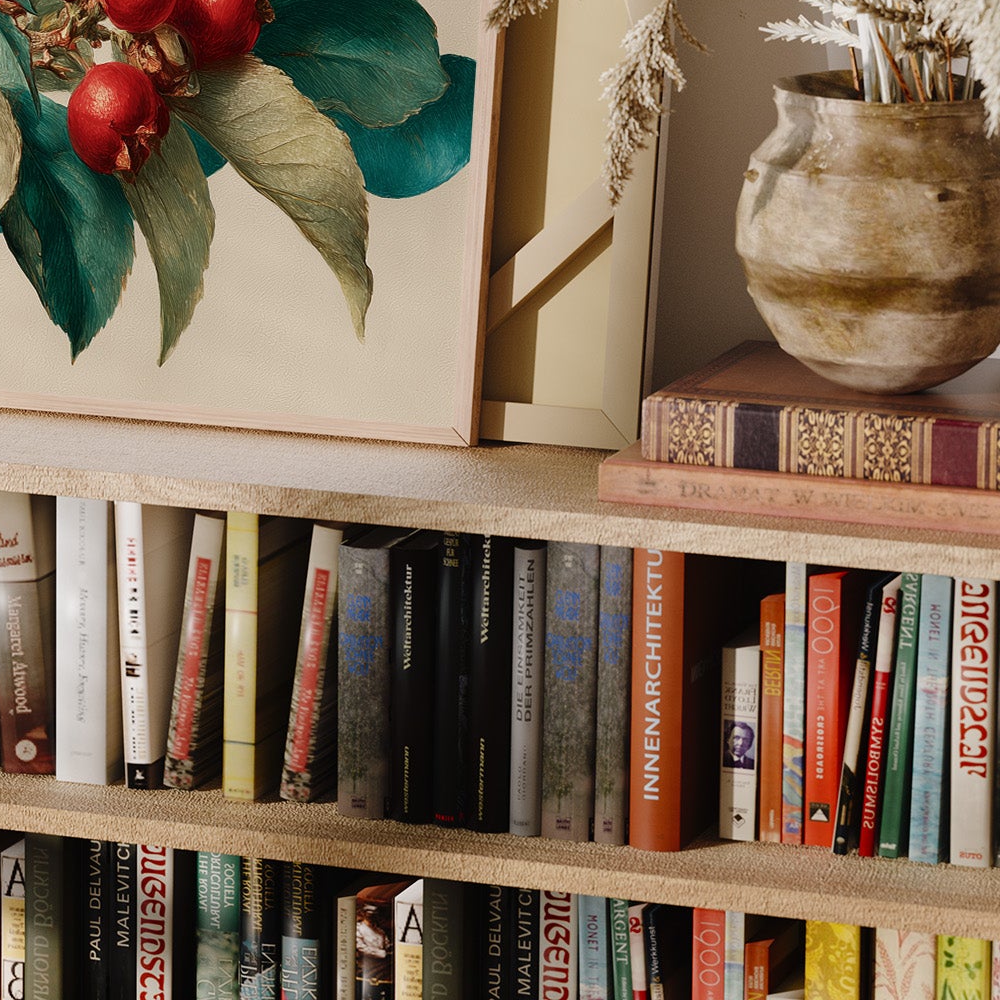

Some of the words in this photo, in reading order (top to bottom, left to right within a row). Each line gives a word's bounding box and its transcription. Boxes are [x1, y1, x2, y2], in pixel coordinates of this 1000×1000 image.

[679, 480, 780, 502] DRAMAT
[793, 492, 813, 506] W
[403, 564, 413, 670] Weltarchitektur
[517, 576, 525, 690] EINSAMKEIT
[525, 559, 535, 679] PRIMZAHLEN
[6, 595, 22, 656] Margaret
[14, 662, 31, 714] Atwood
[643, 549, 663, 800] INNENARCHITEKTU
[516, 695, 524, 722] DIE
[524, 686, 532, 722] DER
[90, 924, 100, 961] PAUL
[401, 905, 422, 943] A
[587, 914, 598, 952] MONET
[629, 917, 641, 933] 2
[588, 959, 596, 973] IN
[650, 925, 659, 975] Werkkunst
[700, 921, 721, 986] 1900
